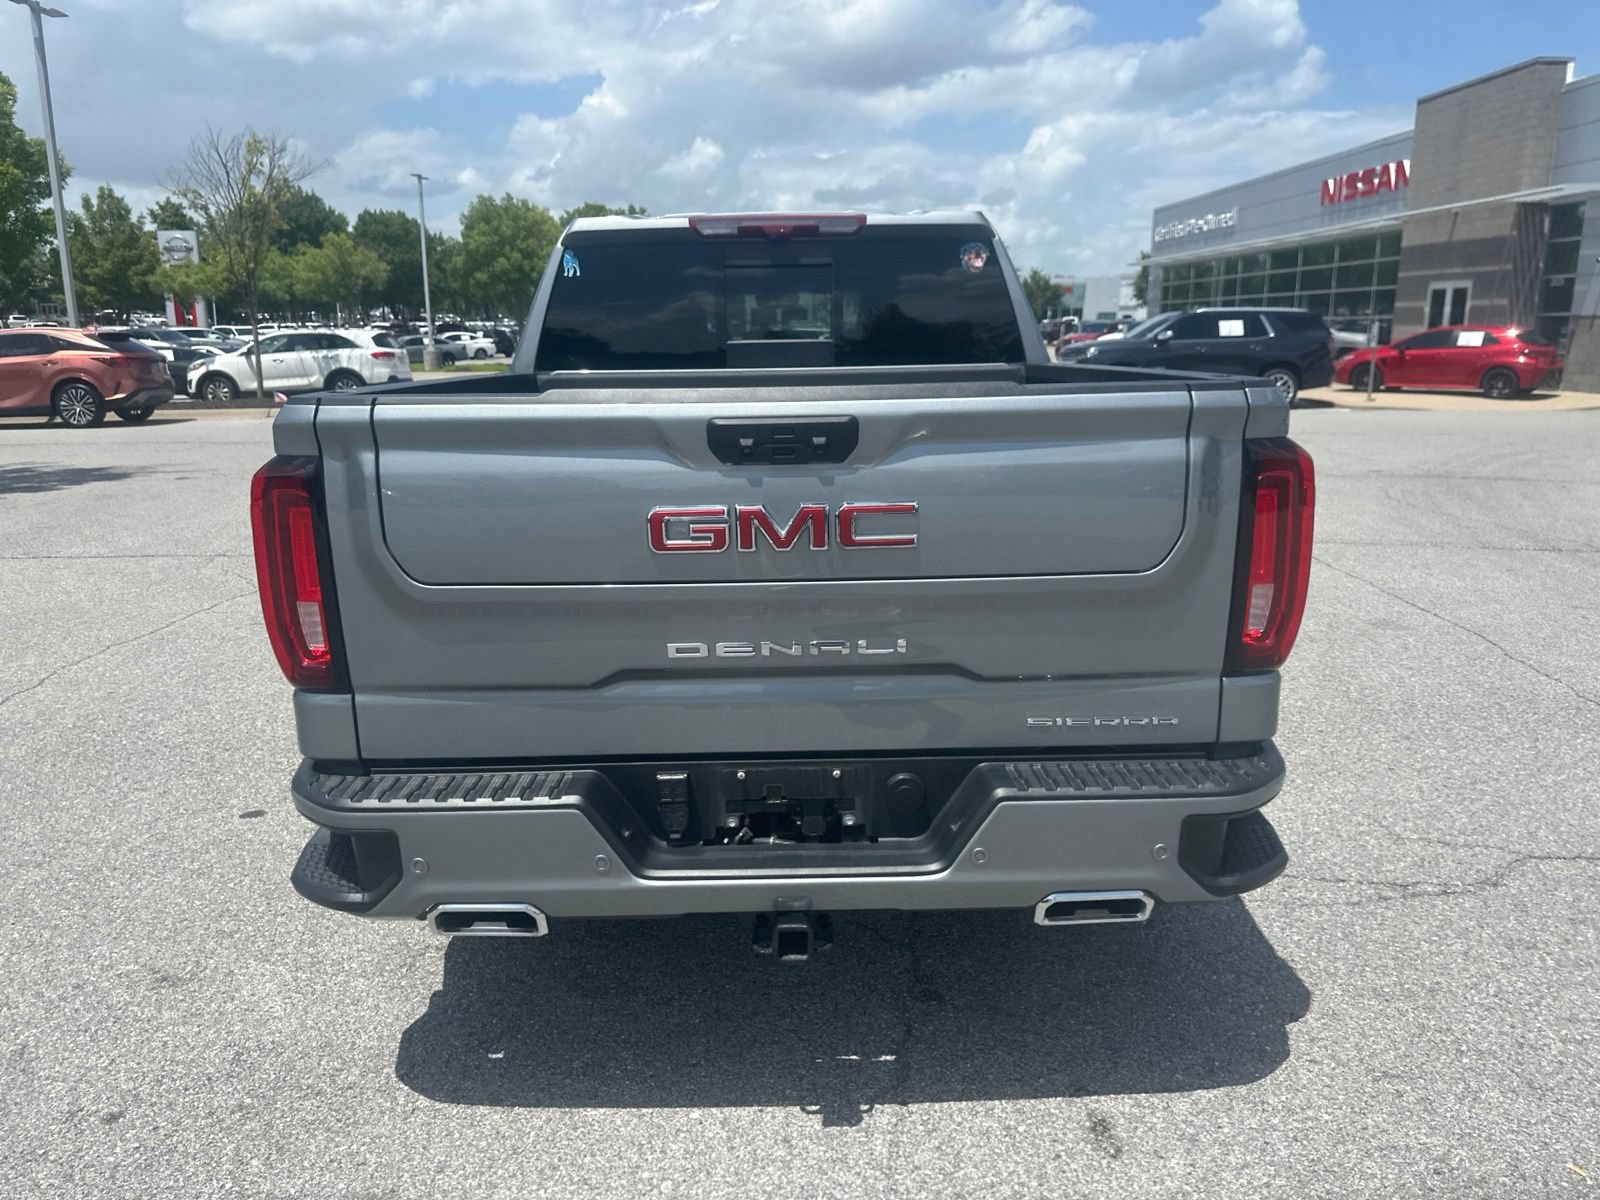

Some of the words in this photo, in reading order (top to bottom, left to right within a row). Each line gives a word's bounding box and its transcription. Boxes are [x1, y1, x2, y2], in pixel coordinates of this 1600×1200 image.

[1320, 160, 1409, 206] NISSAN
[648, 501, 918, 553] GMC
[667, 639, 907, 659] DENALI
[1026, 716, 1179, 727] SIERRA
